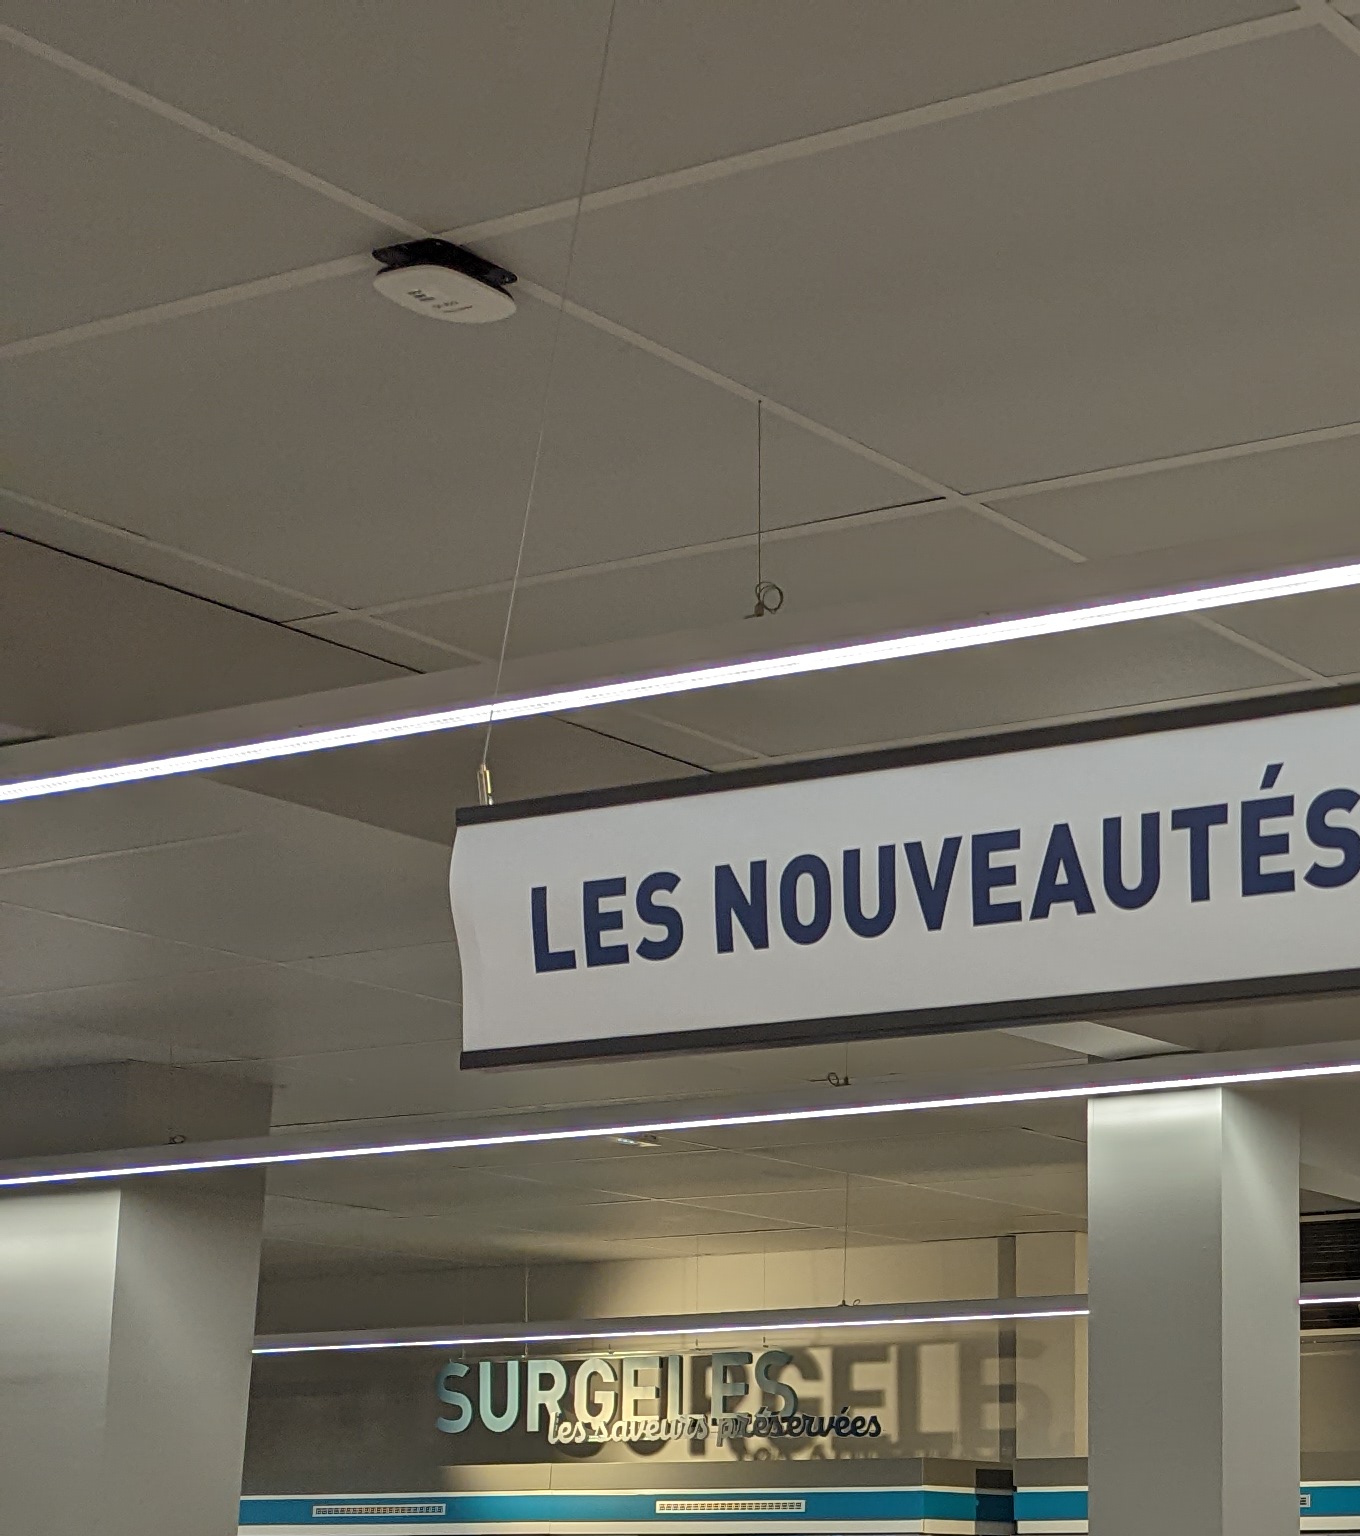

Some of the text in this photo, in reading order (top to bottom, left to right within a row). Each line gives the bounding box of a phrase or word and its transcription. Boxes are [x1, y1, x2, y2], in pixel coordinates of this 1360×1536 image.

[530, 870, 685, 974] LES
[548, 1406, 881, 1448] les saveurs préservées
